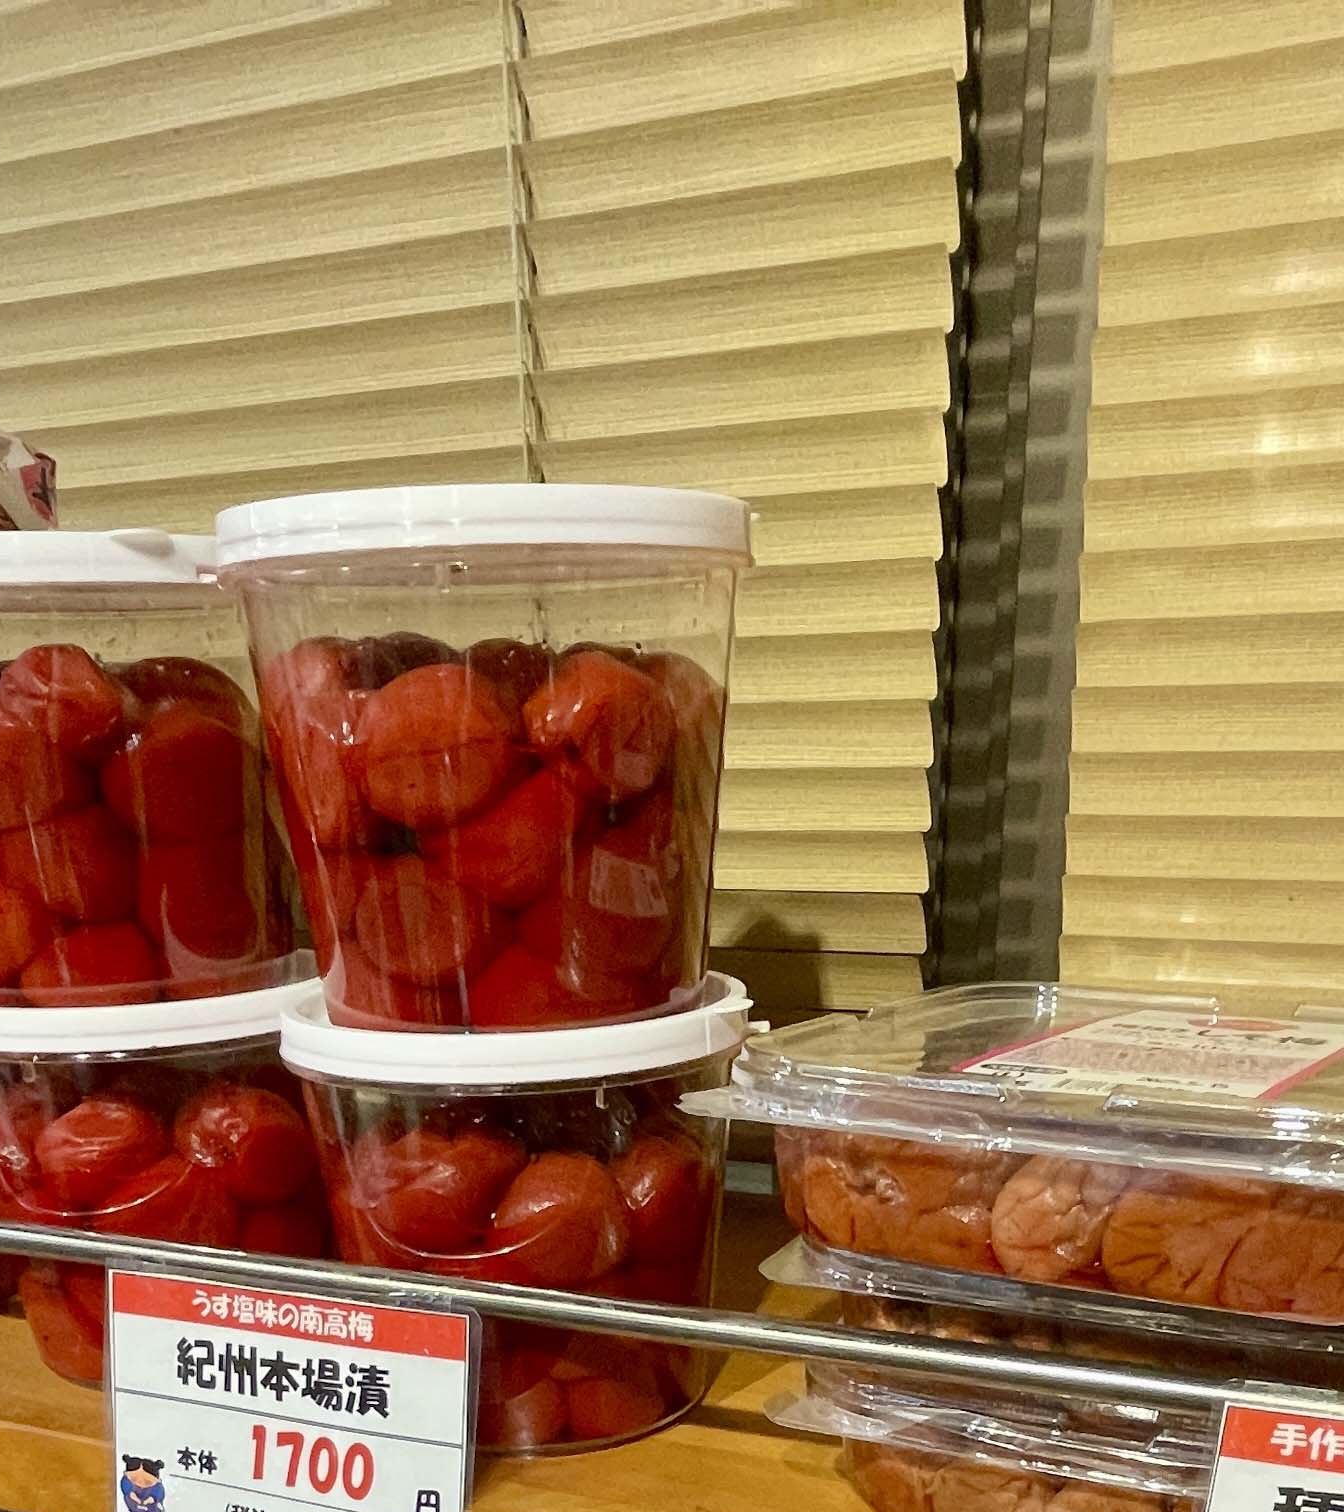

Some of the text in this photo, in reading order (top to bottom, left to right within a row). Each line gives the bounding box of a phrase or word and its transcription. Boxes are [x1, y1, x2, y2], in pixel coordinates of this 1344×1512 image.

[191, 1289, 375, 1343] うす塩味の南高梅
[175, 1335, 391, 1419] 紀州本場漬
[176, 1446, 218, 1475] 本体
[251, 1423, 375, 1501] 1700
